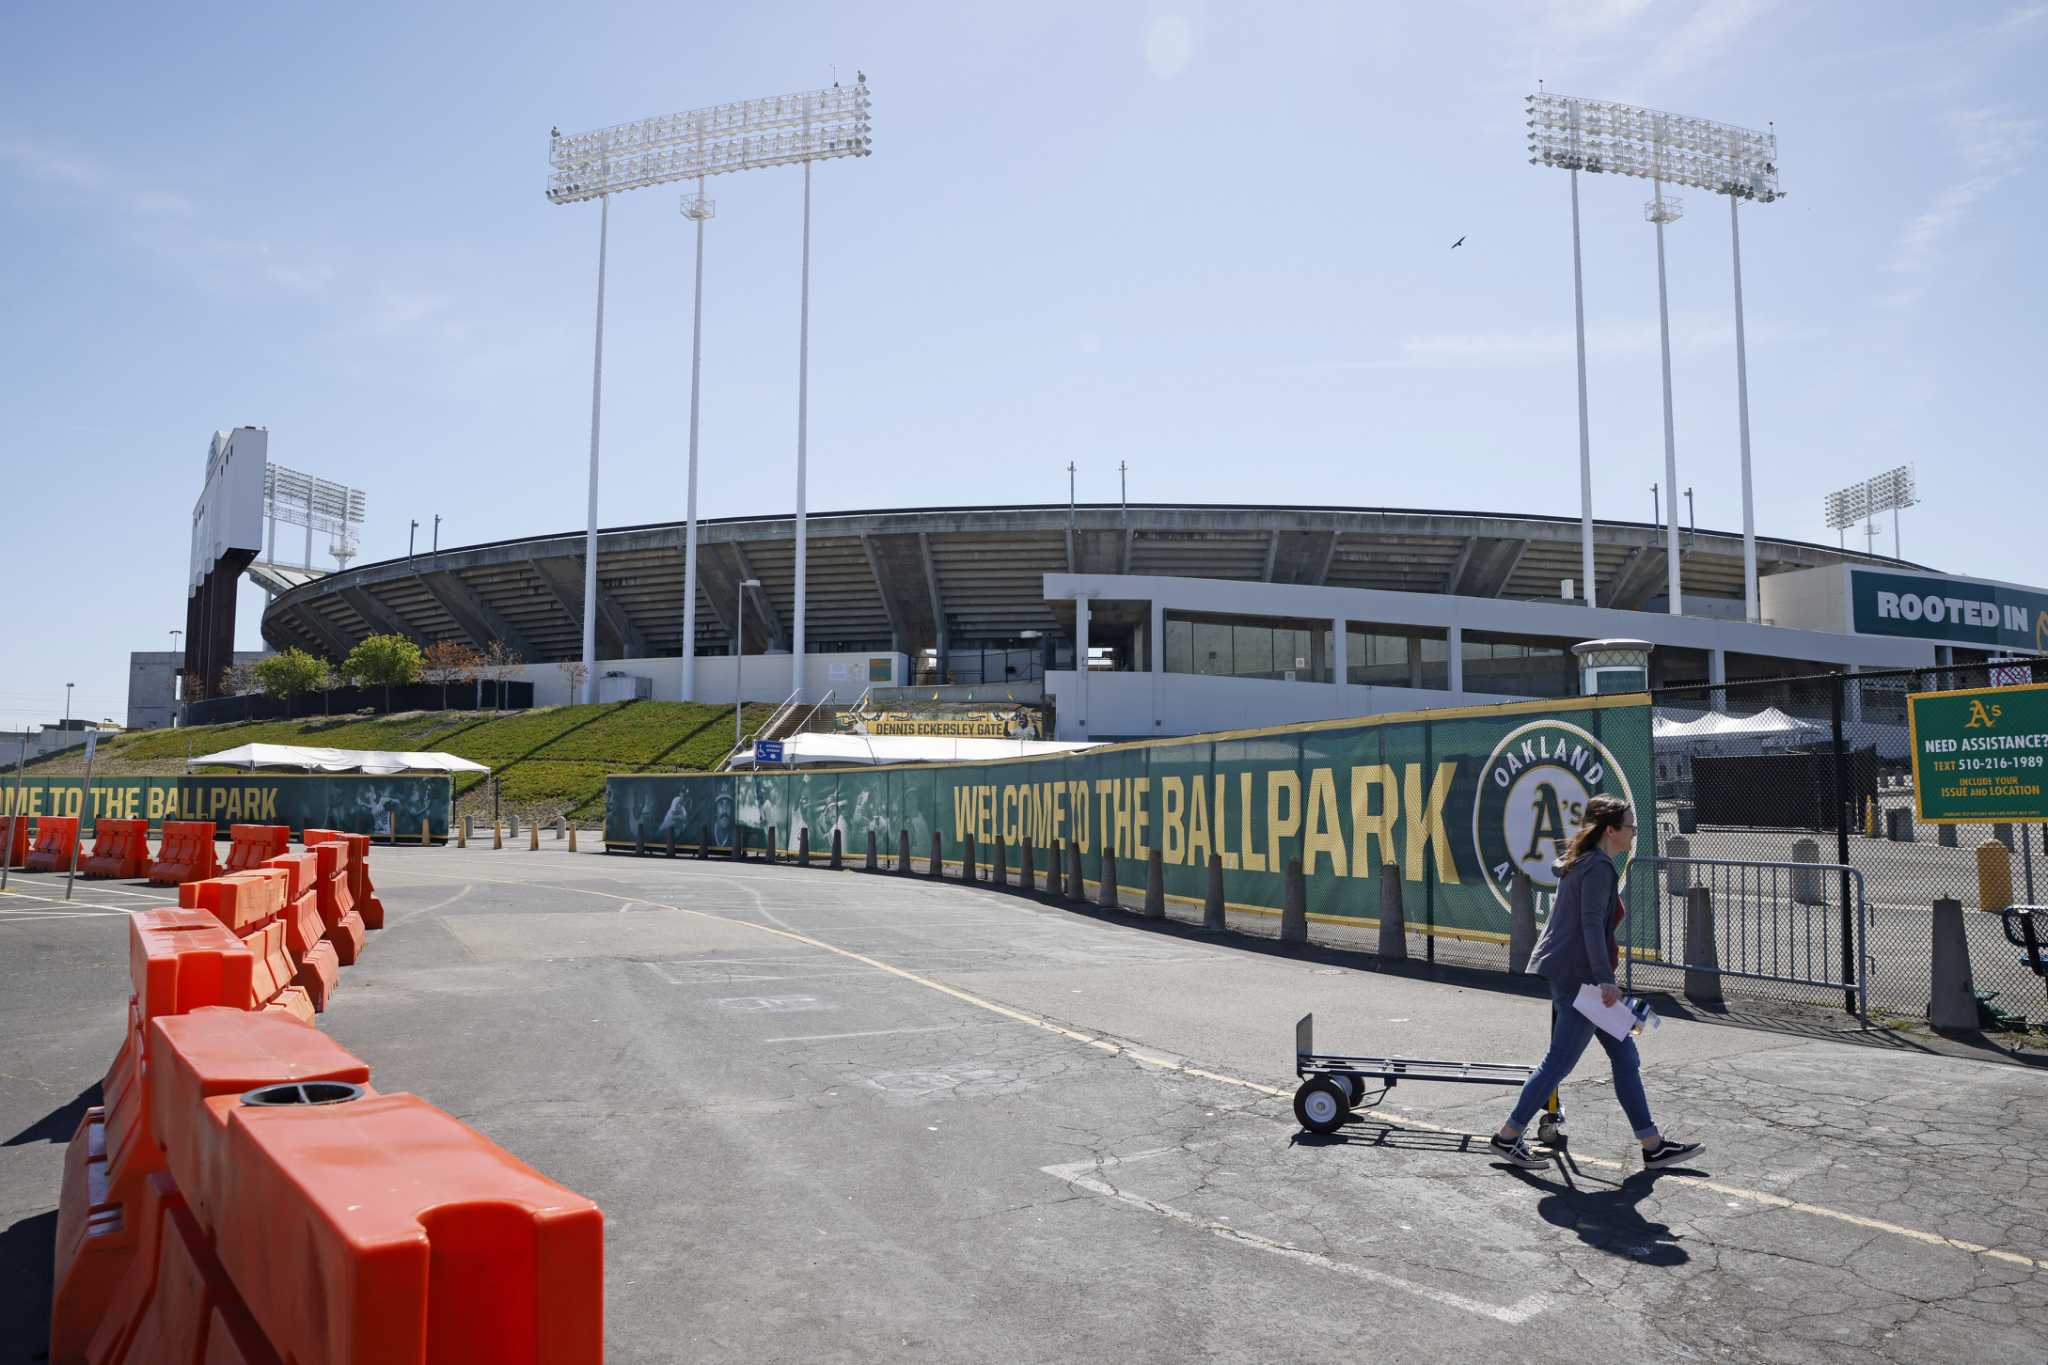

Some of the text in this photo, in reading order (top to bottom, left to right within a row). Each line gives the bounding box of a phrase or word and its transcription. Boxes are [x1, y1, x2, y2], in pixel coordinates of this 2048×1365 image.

[1877, 590, 2029, 633] ROOTED IN
[876, 722, 1002, 736] DENNIS ECKERSLEY GATE
[1925, 734, 2048, 753] NEED ASSISTANCE?
[1494, 736, 1604, 788] OAKLAND
[1934, 756, 2043, 771] TEXT 510-216-1989
[1960, 776, 2018, 786] INCLUDE YOUR
[1942, 787, 1968, 797] ISSUE
[1990, 785, 2040, 796] LOCATION
[0, 787, 278, 820] ME TO THE BALLPARK
[1095, 777, 1150, 860] THE
[1162, 762, 1461, 884] BALLPARK
